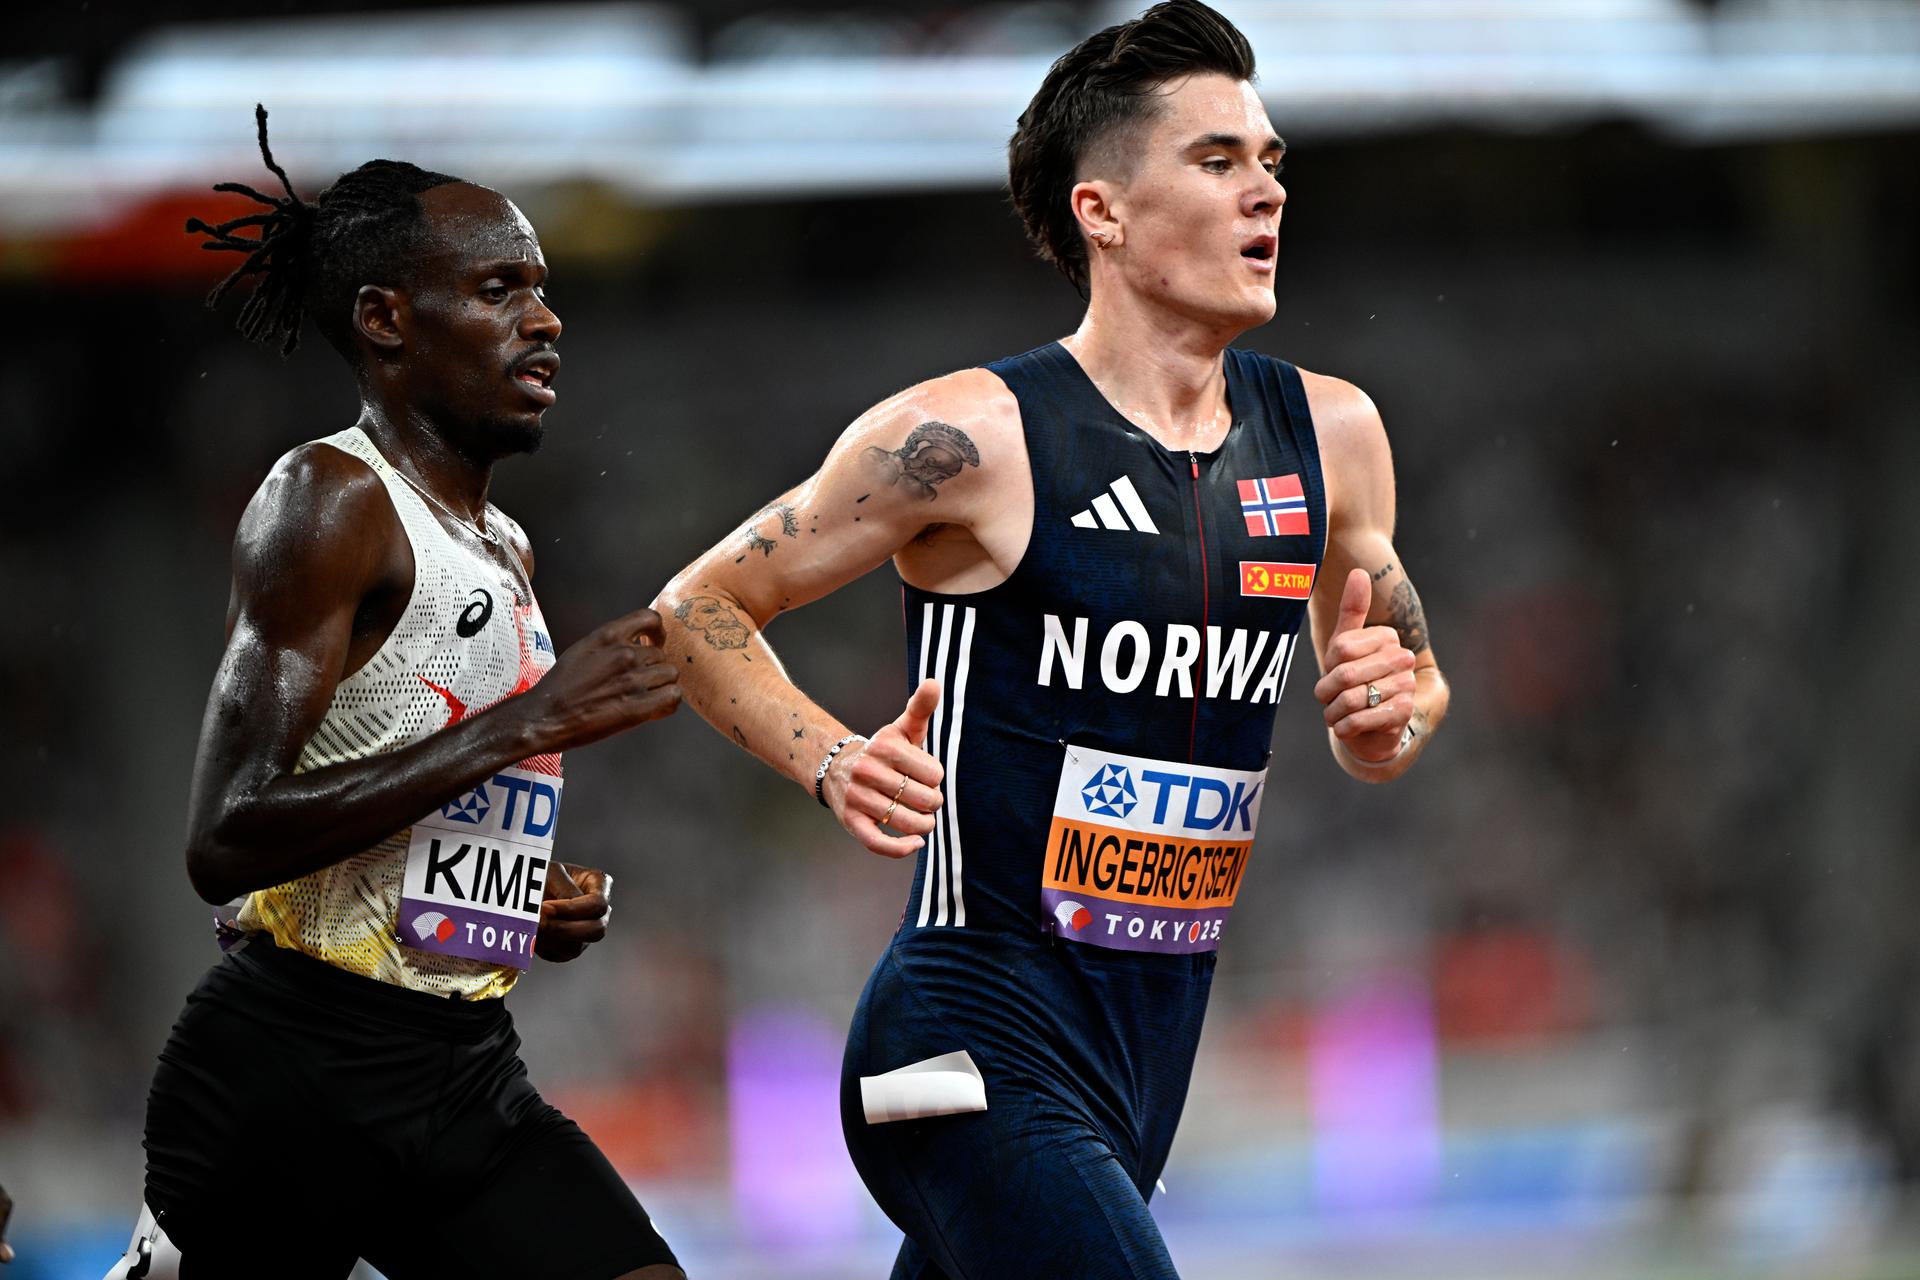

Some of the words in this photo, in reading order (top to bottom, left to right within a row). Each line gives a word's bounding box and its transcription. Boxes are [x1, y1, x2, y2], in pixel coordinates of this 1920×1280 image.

[1274, 573, 1310, 589] EXTRA
[492, 774, 562, 840] TD
[1141, 769, 1262, 832] TDK
[424, 838, 547, 914] KIME
[1054, 827, 1249, 901] INGEBRIGTSEN
